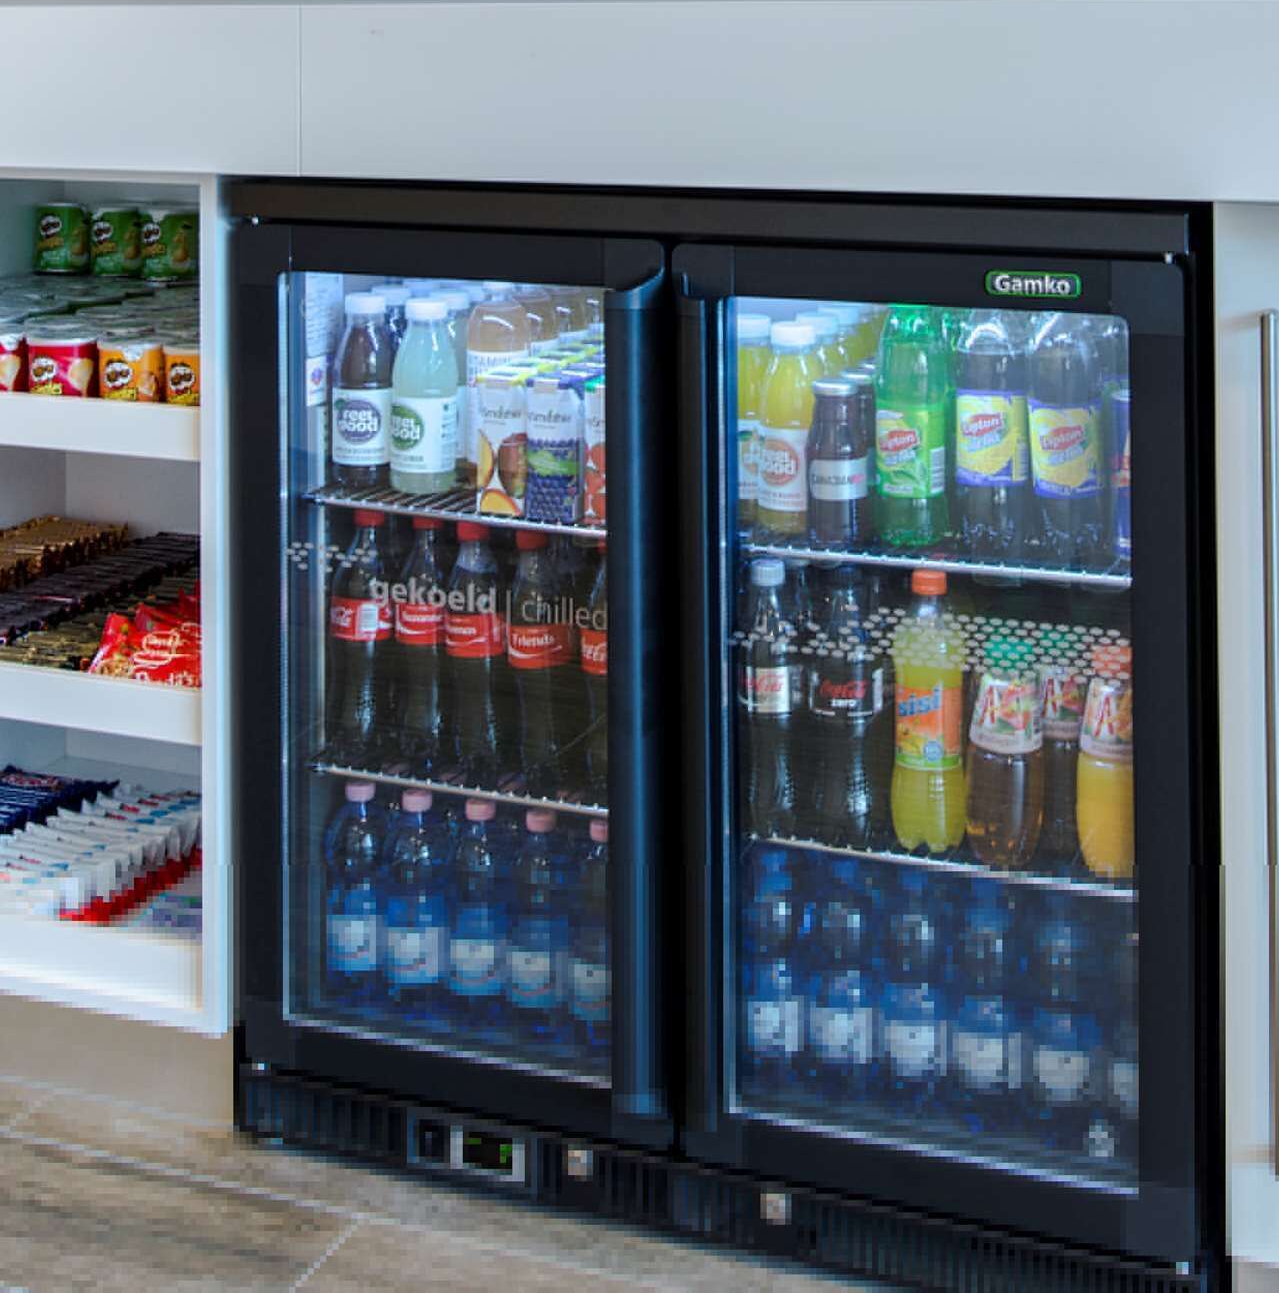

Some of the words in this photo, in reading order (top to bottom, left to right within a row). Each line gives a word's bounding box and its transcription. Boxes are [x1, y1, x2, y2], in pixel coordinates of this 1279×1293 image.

[994, 274, 1071, 295] Gamko
[370, 577, 497, 615] gekoeld
[522, 592, 608, 632] chilled
